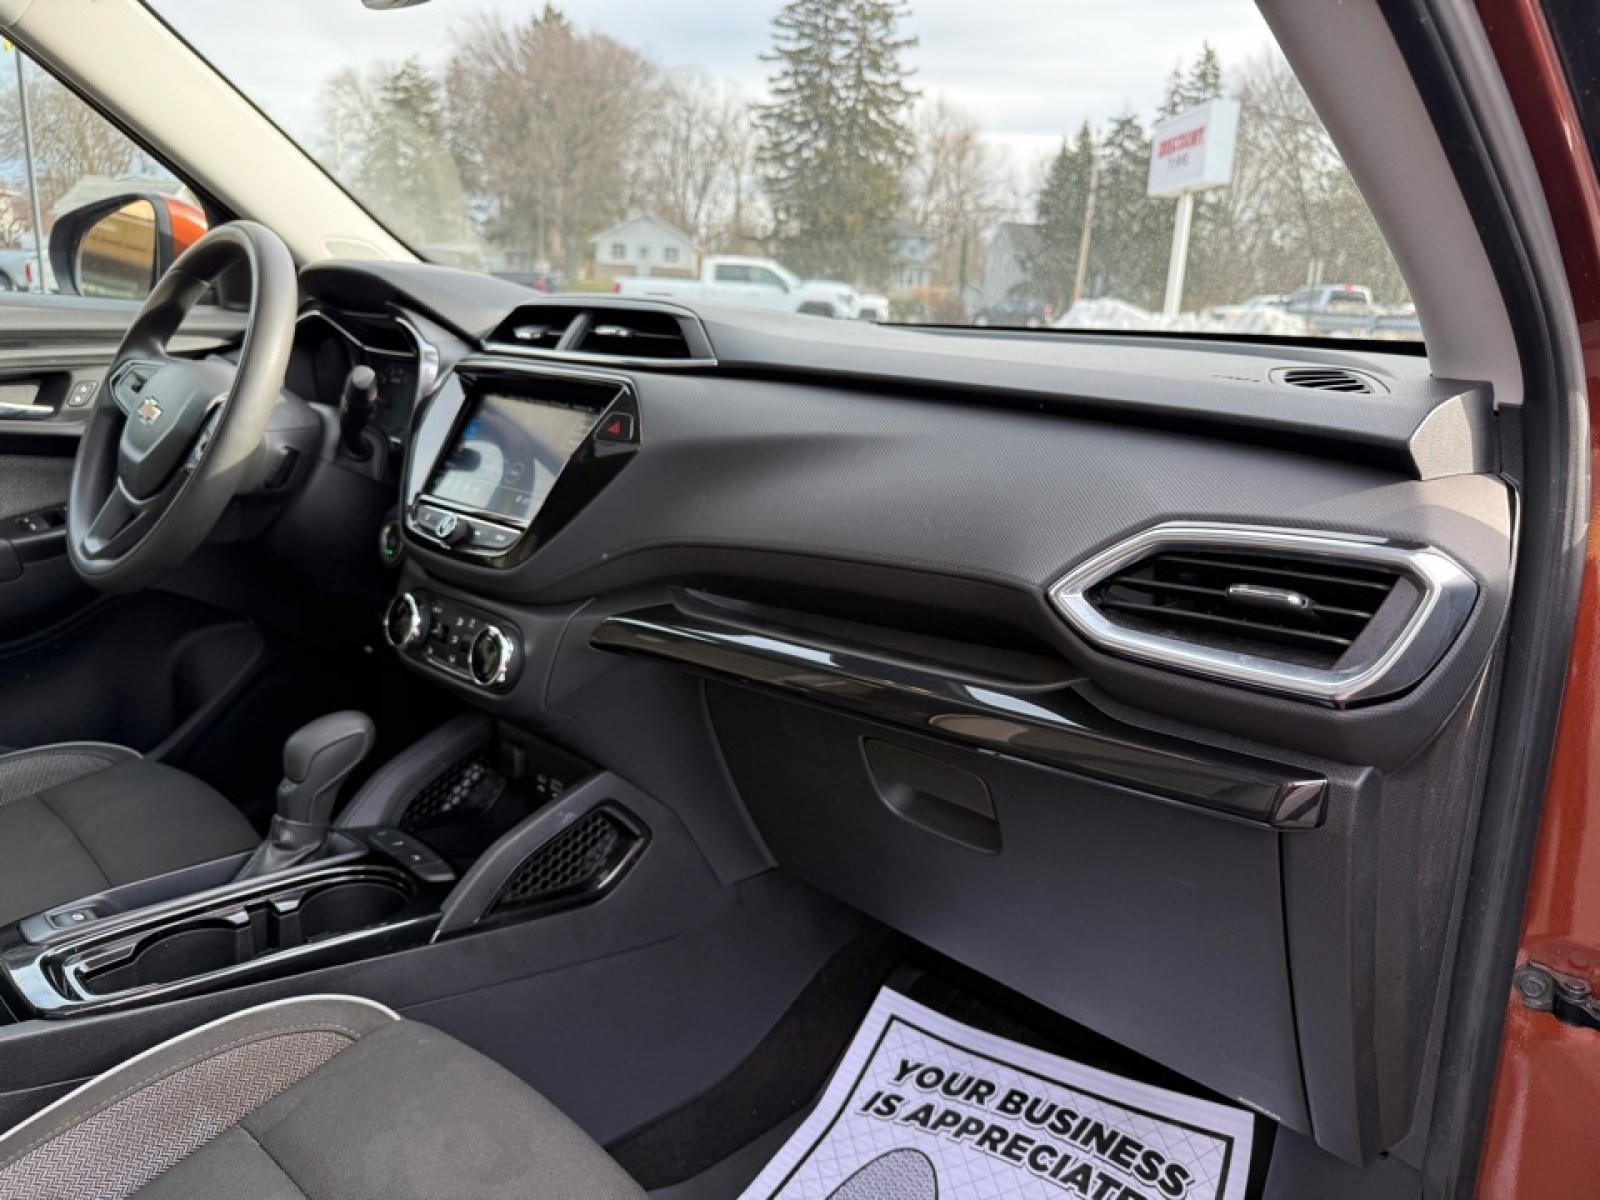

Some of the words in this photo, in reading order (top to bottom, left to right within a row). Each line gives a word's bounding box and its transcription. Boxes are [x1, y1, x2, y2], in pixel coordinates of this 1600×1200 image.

[859, 1091, 905, 1117] IS
[892, 1059, 997, 1106] YOUR
[995, 1088, 1191, 1197] BUSINESS
